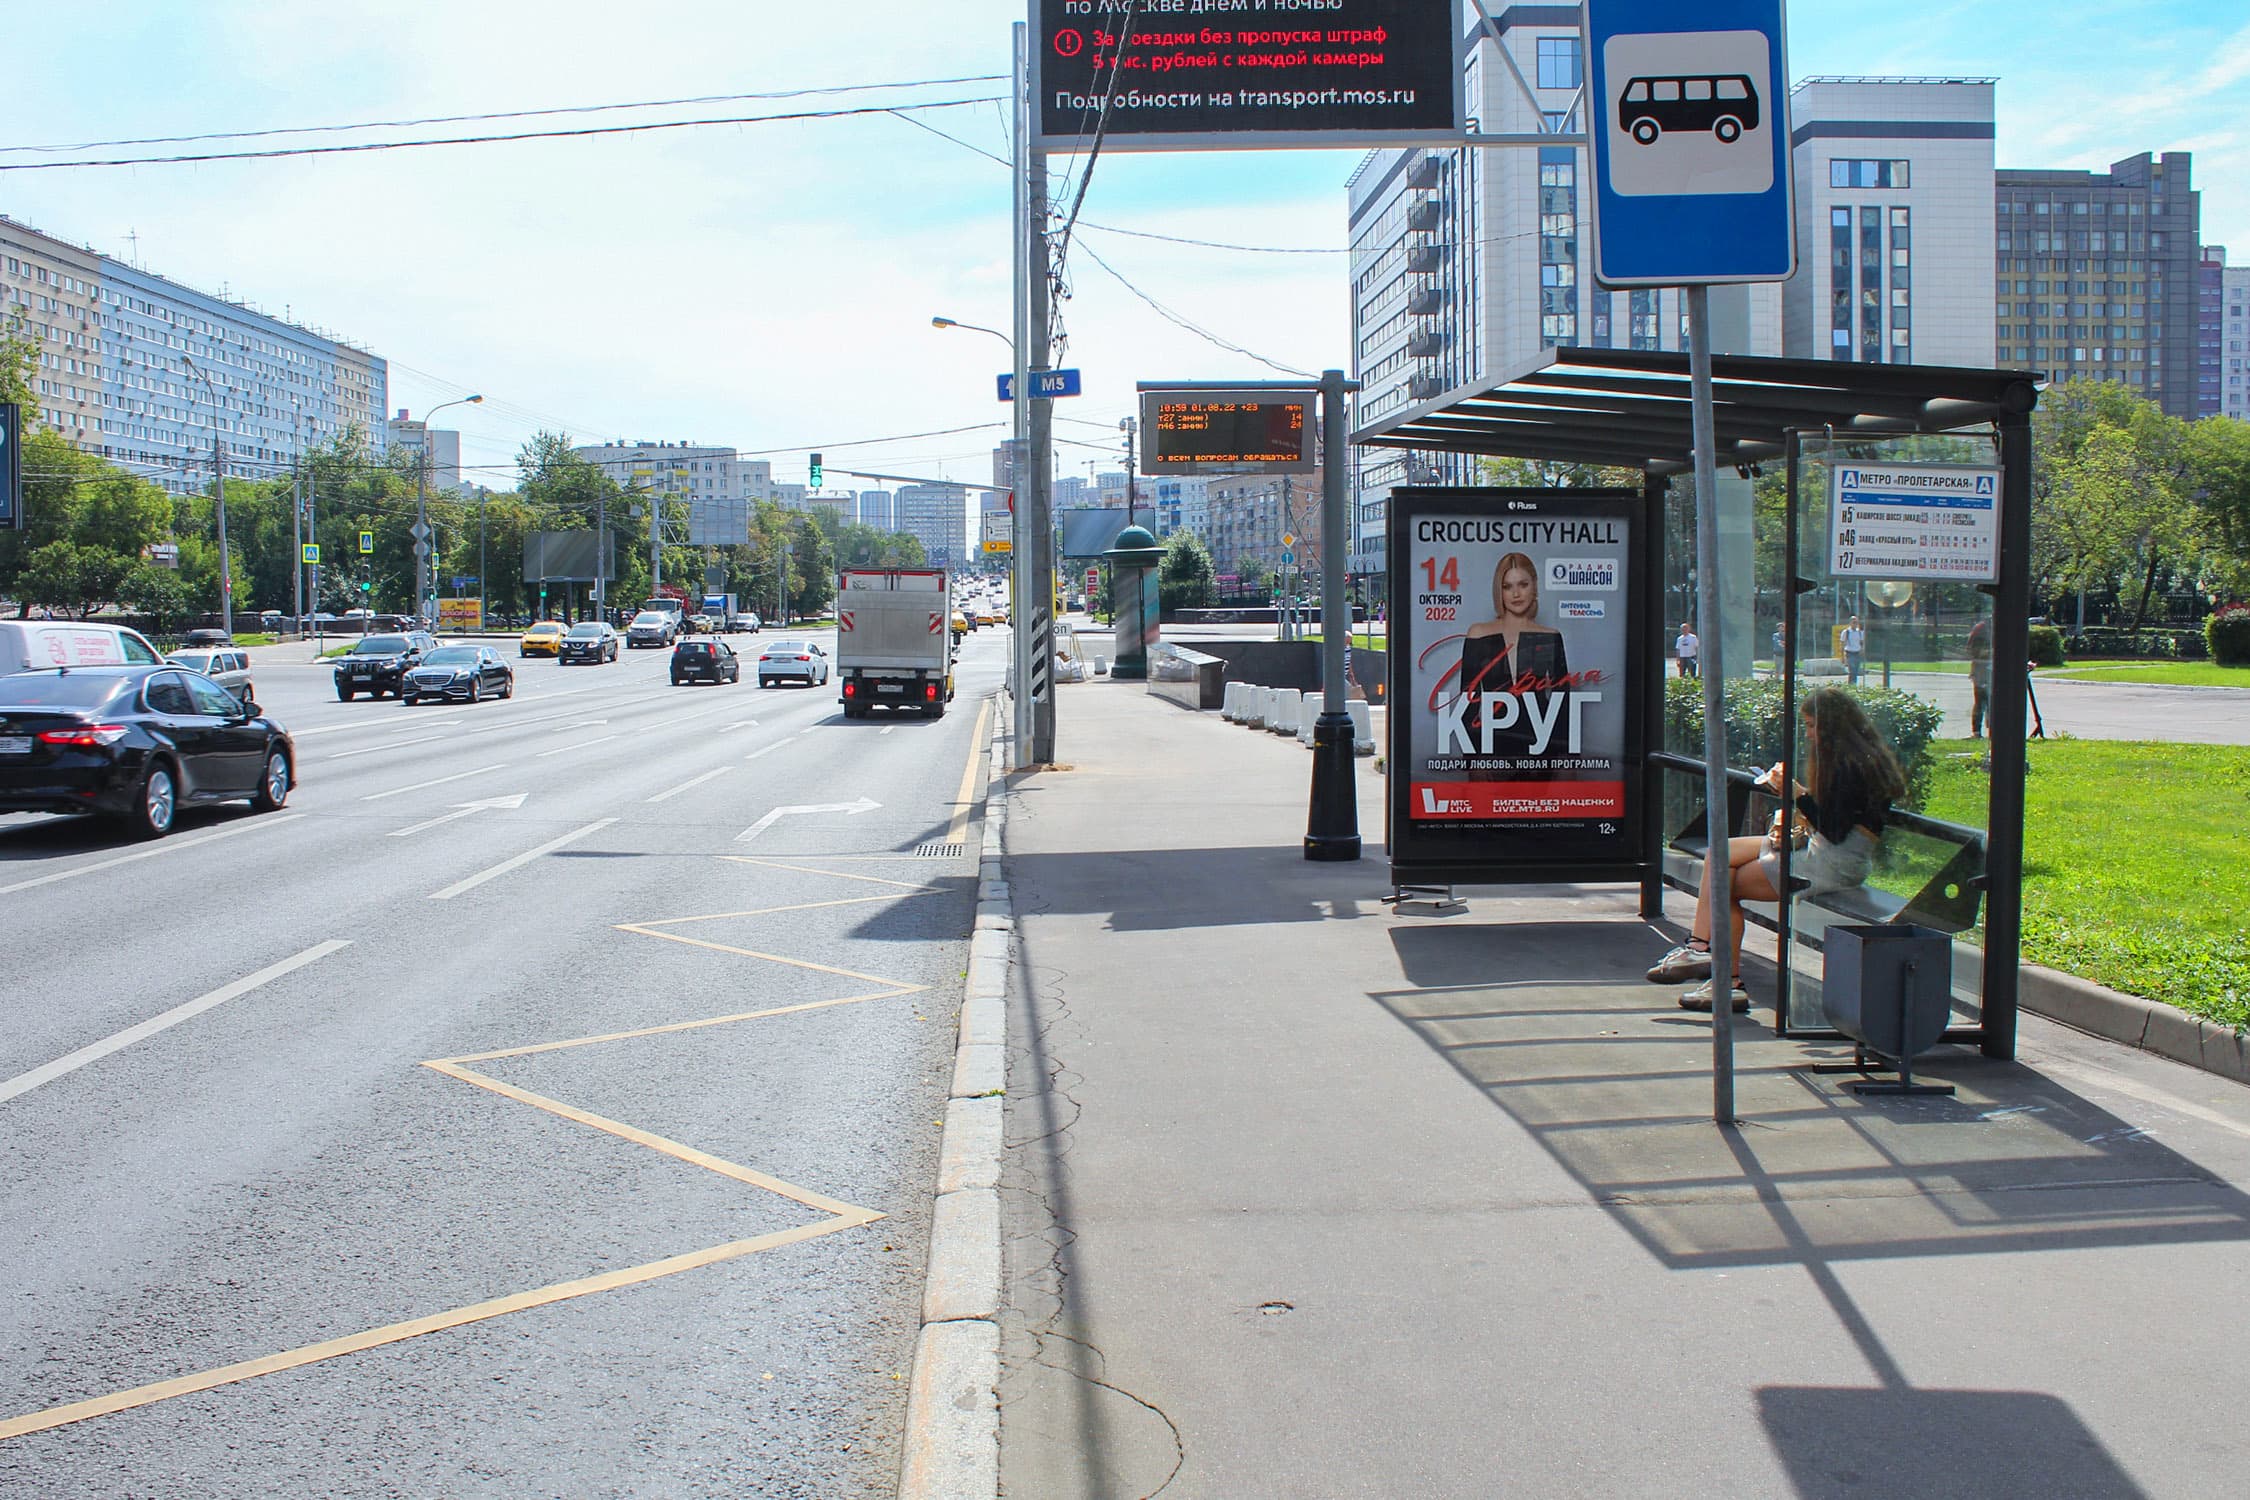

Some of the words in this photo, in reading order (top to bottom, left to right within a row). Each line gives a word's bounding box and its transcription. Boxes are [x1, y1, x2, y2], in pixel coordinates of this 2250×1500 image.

[1097, 0, 1186, 13] Мокве
[1253, 0, 1268, 10] и
[1275, 0, 1343, 10] ночью
[1093, 29, 1115, 46] За
[1200, 28, 1232, 44] без
[1238, 30, 1321, 46] пропуска
[1327, 25, 1387, 45] штраф
[1093, 54, 1105, 69] 5
[1152, 51, 1217, 71] рублей
[1222, 54, 1232, 66] с
[1238, 50, 1307, 67] каждой
[1313, 52, 1384, 69] камеры
[1208, 92, 1233, 106] на
[1239, 88, 1415, 109] transport.mos.ru
[1041, 376, 1065, 392] М5
[1159, 403, 1188, 412] 10:59
[1191, 403, 1236, 412] 01.08.22
[1241, 403, 1258, 412] +23
[1860, 474, 1891, 485] МЕТРО
[1517, 502, 1537, 510] Russ
[1418, 521, 1504, 543] CROCUS
[1509, 522, 1556, 543] CITY
[1560, 522, 1619, 544] HALL
[1421, 557, 1460, 592] 14
[1569, 571, 1613, 585] ШАНСОН
[1419, 595, 1462, 605] ОКТЯБРЯ
[1425, 607, 1456, 621] 2022
[1438, 691, 1602, 755] КРУГ
[1428, 760, 1467, 770] ПОДАРИ
[1470, 760, 1514, 769] ЛЮБОВЬ.
[1516, 760, 1548, 769] НОВАЯ
[1551, 760, 1610, 769] ПРОГРАММА
[1599, 823, 1616, 834] 12+
